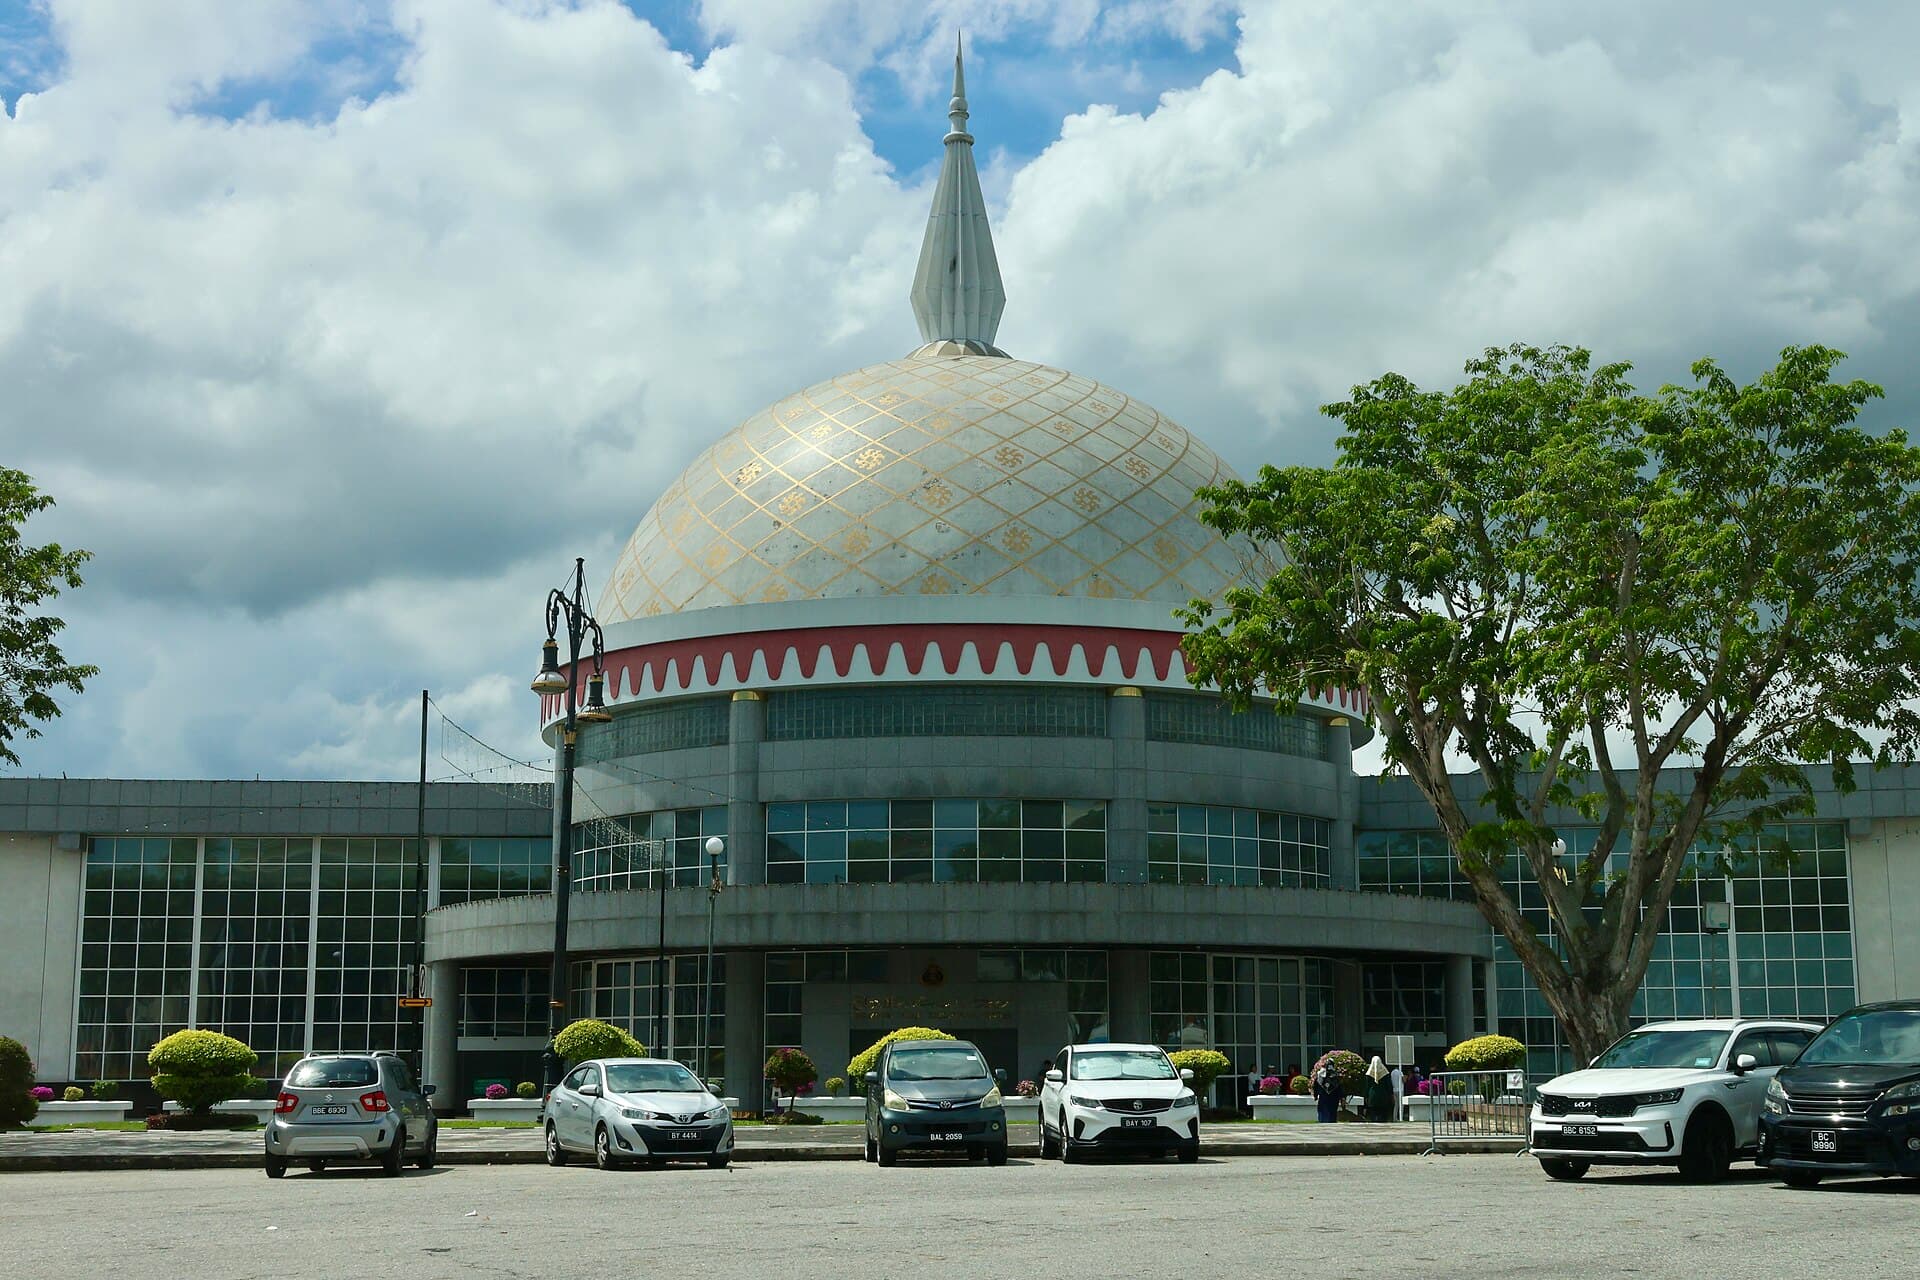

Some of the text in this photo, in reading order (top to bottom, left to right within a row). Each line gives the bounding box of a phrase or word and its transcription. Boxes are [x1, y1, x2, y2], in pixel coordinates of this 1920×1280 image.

[1563, 1126, 1596, 1135] BBC 6152
[930, 1133, 963, 1141] BAL 2059
[1818, 1132, 1829, 1141] BC
